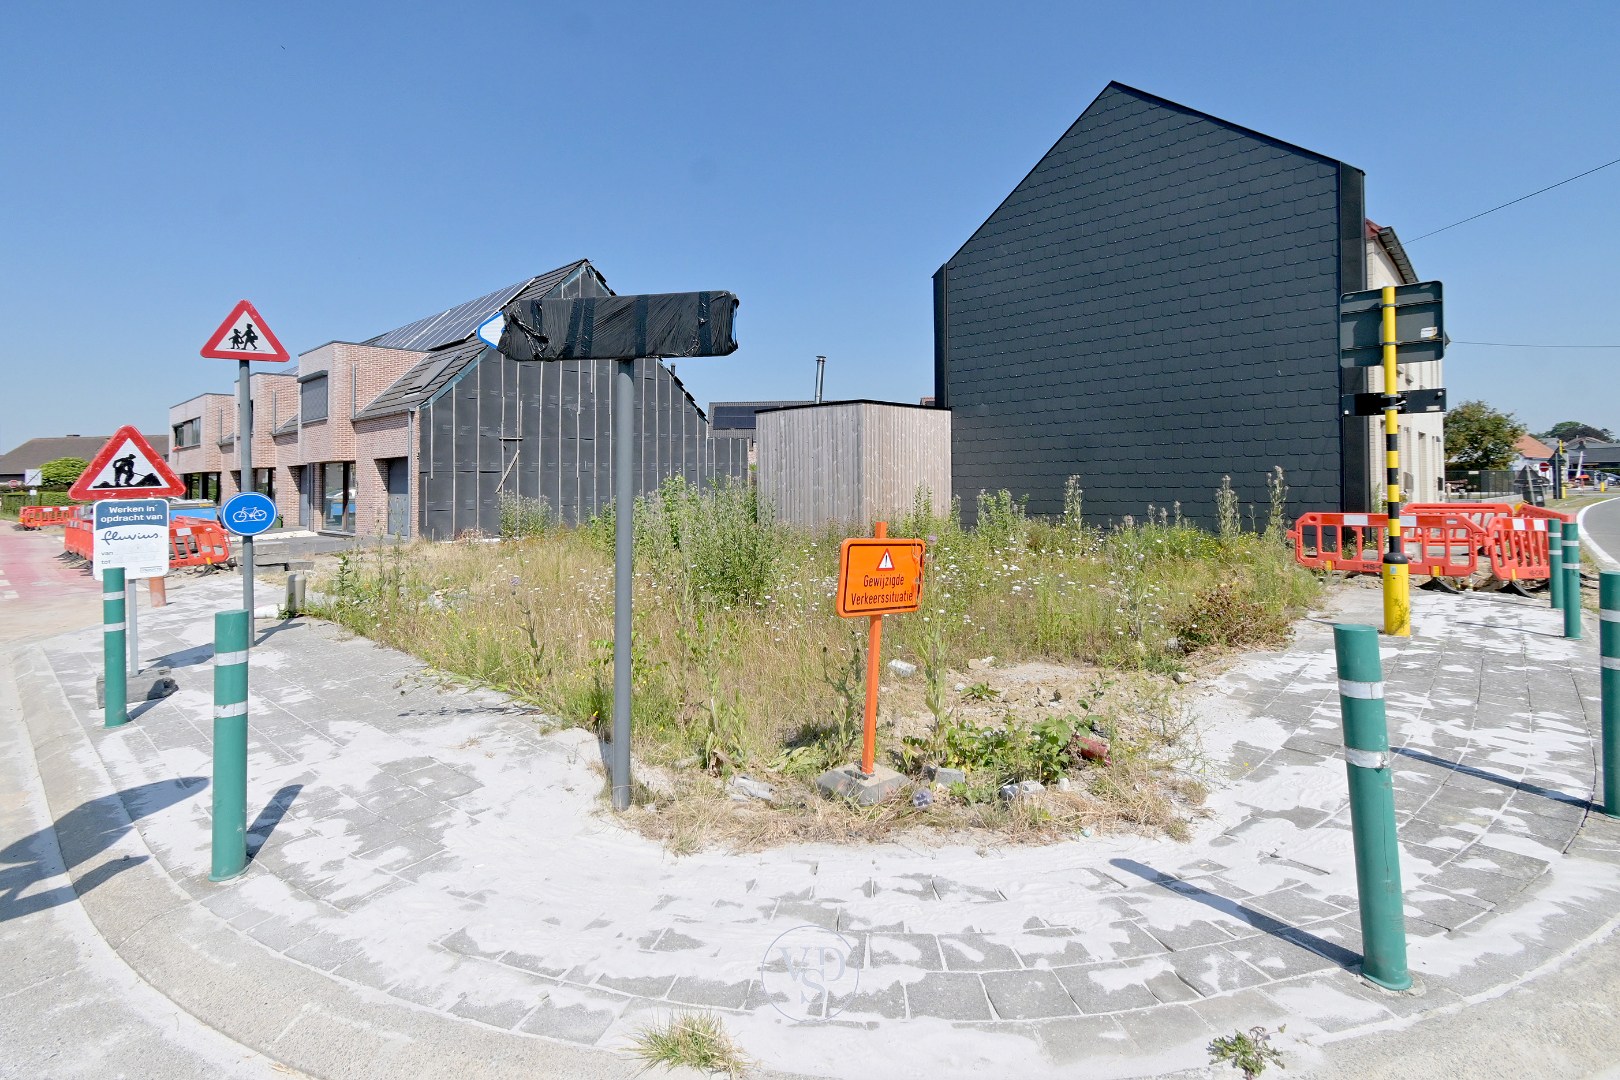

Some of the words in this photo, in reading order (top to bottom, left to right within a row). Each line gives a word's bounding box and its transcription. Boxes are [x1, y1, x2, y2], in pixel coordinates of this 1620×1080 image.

[109, 506, 144, 514] Werken
[100, 514, 144, 523] opdracht
[863, 574, 905, 590] Gewijzigde
[851, 590, 914, 606] Verkeerssituatie
